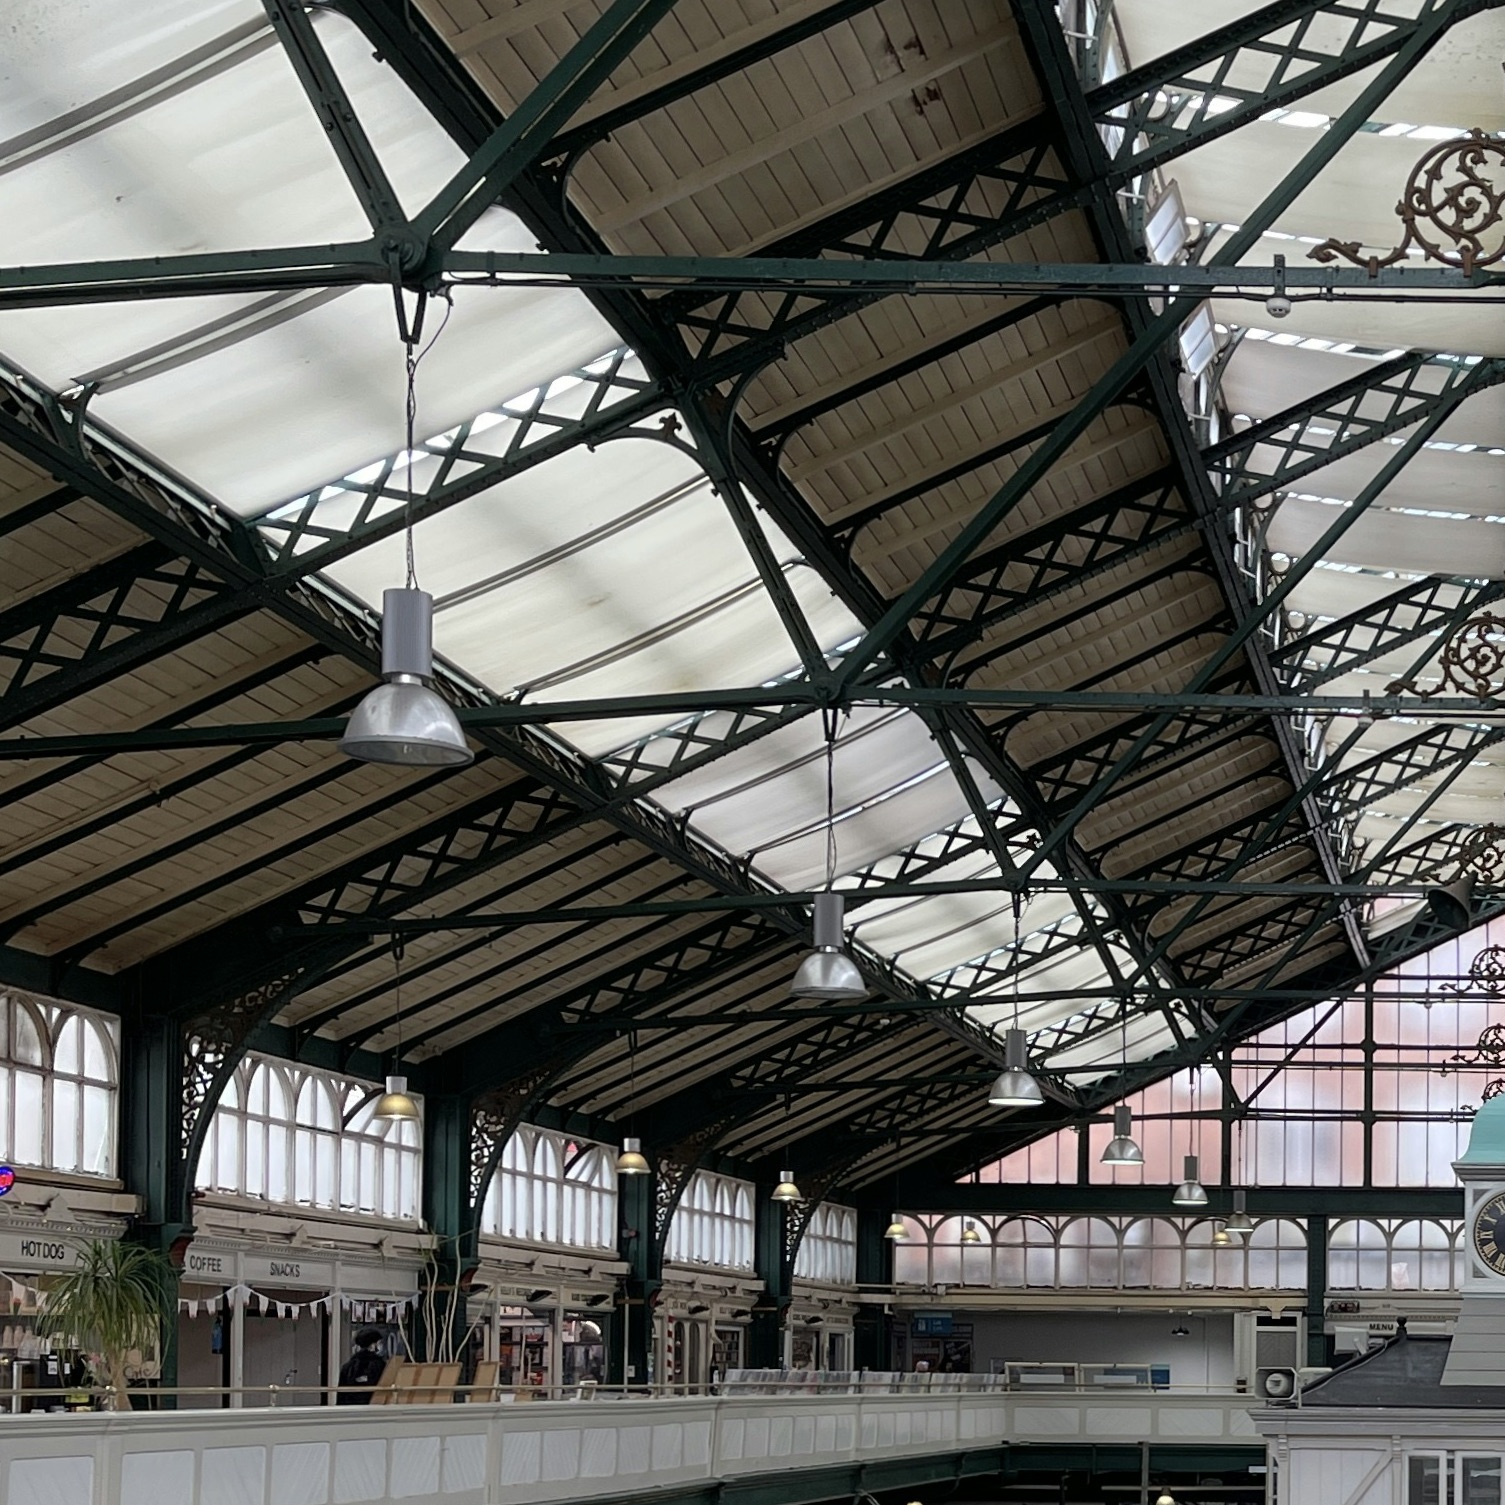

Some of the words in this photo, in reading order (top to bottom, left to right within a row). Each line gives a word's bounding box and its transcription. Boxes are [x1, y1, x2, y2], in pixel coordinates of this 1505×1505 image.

[21, 1240, 42, 1258] HOT
[43, 1242, 65, 1260] DOG
[189, 1255, 222, 1273] COFFEE
[270, 1262, 300, 1278] SNACKS
[1369, 1323, 1394, 1332] MENU
